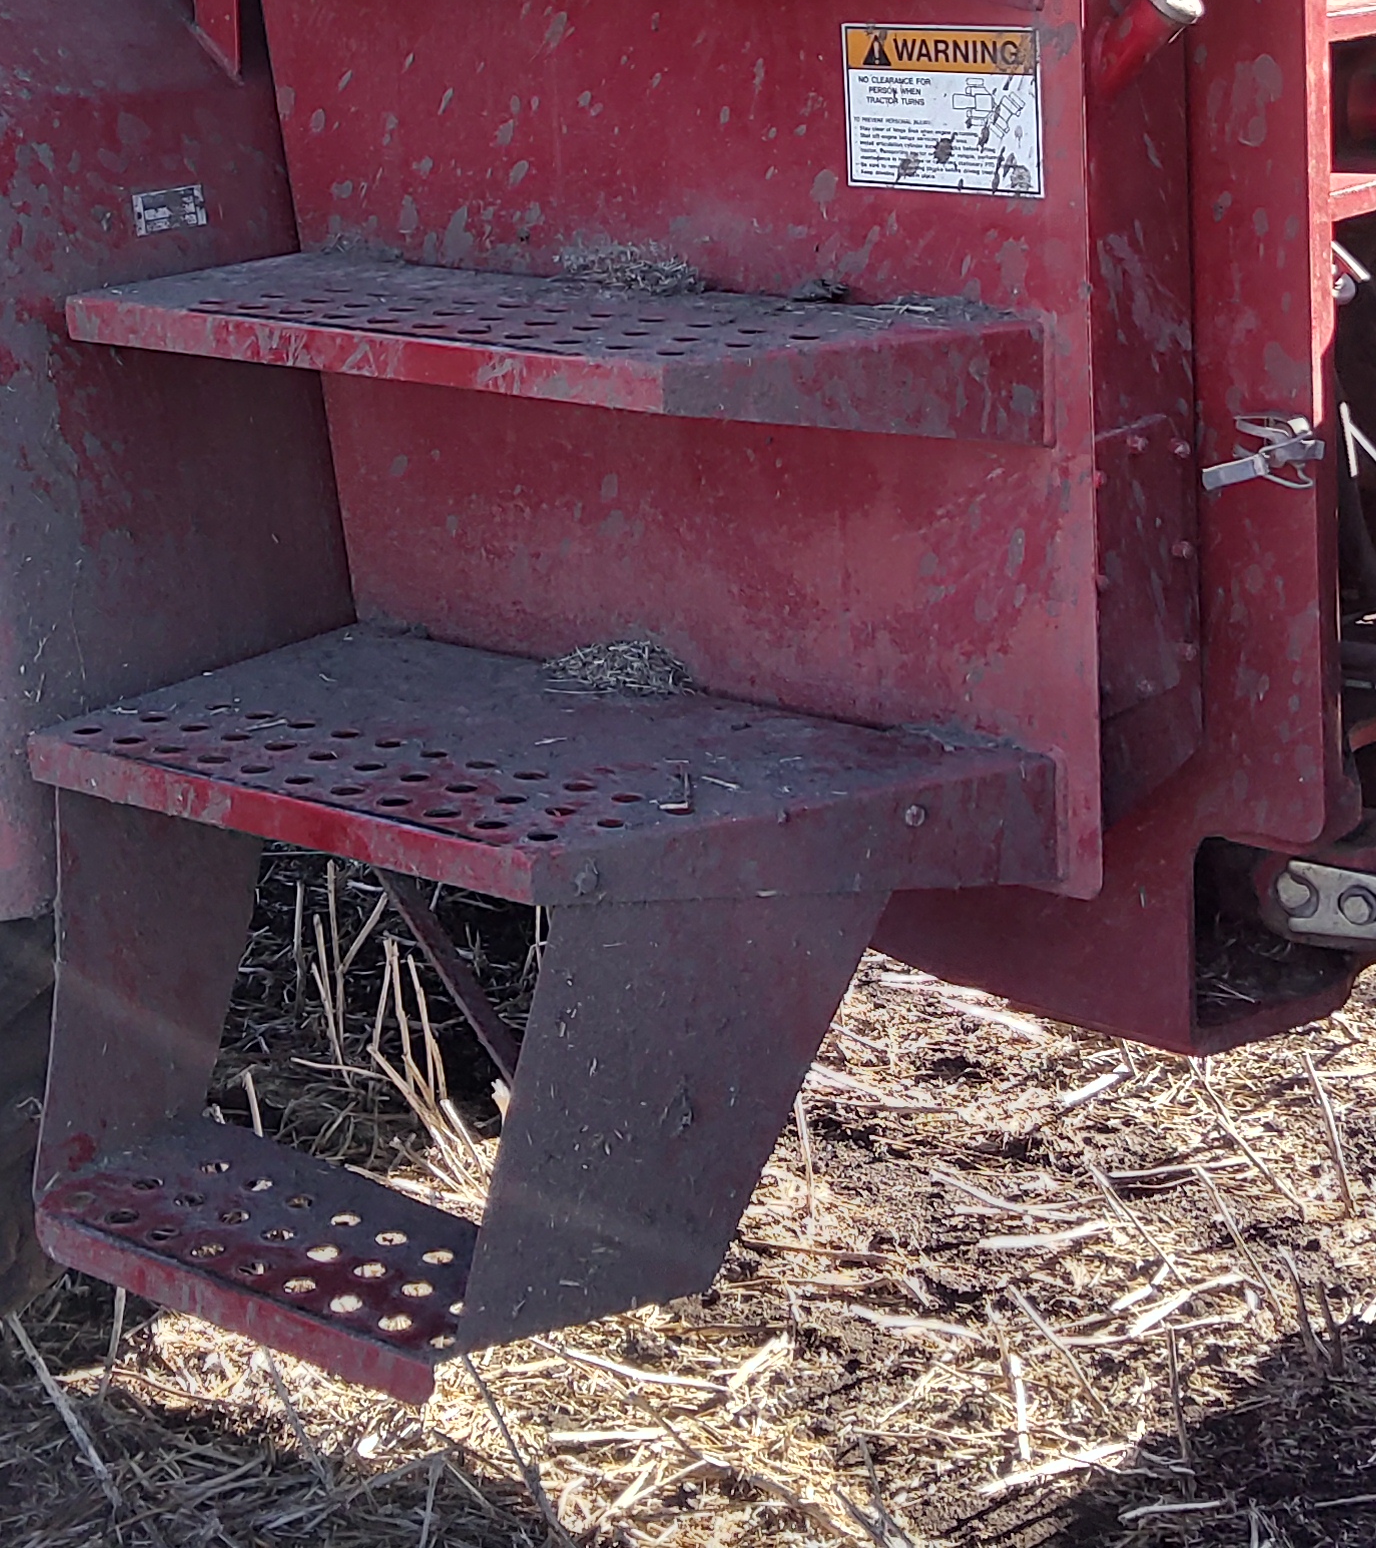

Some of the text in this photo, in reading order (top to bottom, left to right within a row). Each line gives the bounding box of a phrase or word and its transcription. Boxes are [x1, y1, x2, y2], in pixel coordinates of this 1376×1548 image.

[893, 37, 1020, 65] WARNING
[858, 75, 931, 86] NO CLEARANCE FOR
[868, 86, 921, 96] PERSON WHEN
[866, 96, 925, 106] TRACTOR TURNS
